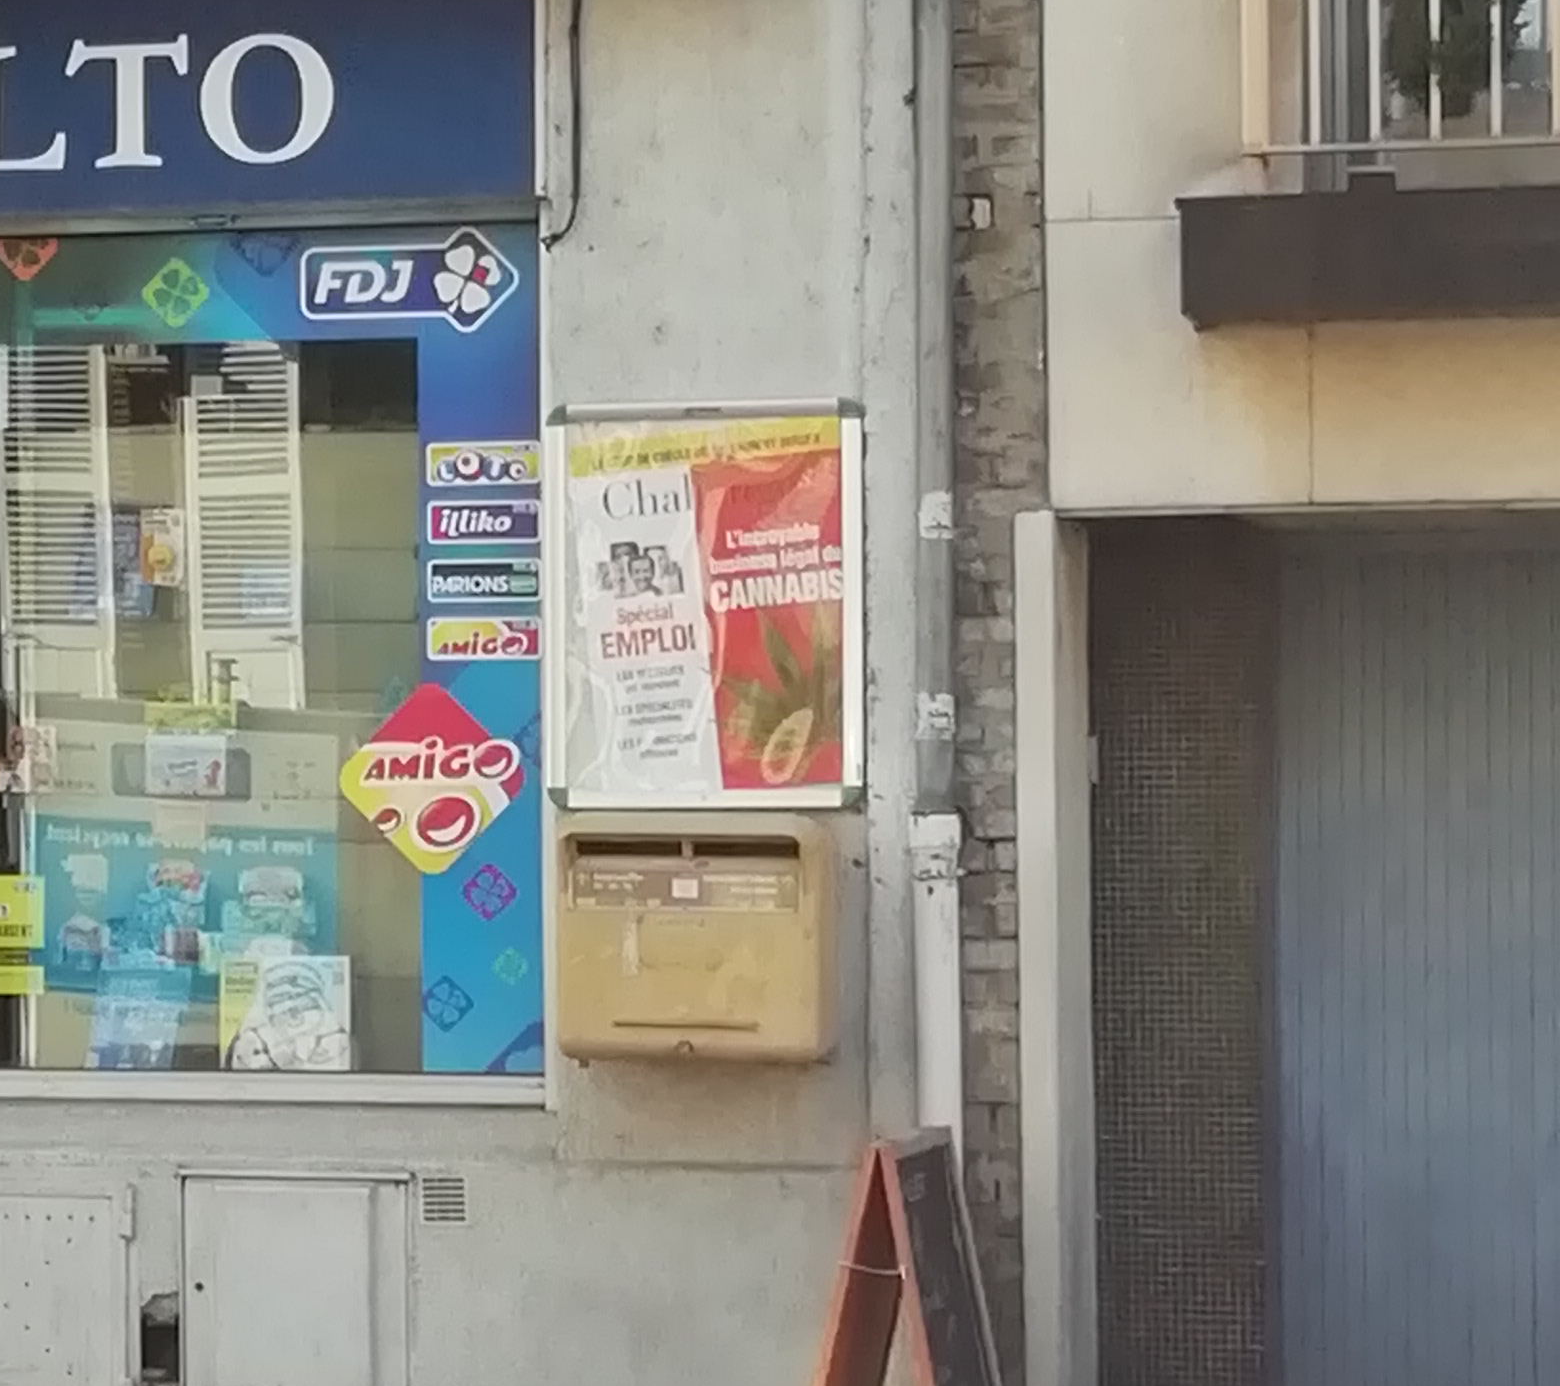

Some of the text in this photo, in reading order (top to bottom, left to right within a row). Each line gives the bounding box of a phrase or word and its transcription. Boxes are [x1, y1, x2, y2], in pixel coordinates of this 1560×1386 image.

[314, 259, 414, 305] FDJ
[437, 448, 528, 482] LOTO
[439, 508, 513, 537] illiko
[432, 574, 509, 594] PARIONS
[710, 569, 843, 612] CANNABIS
[600, 623, 696, 659] EMPLOI
